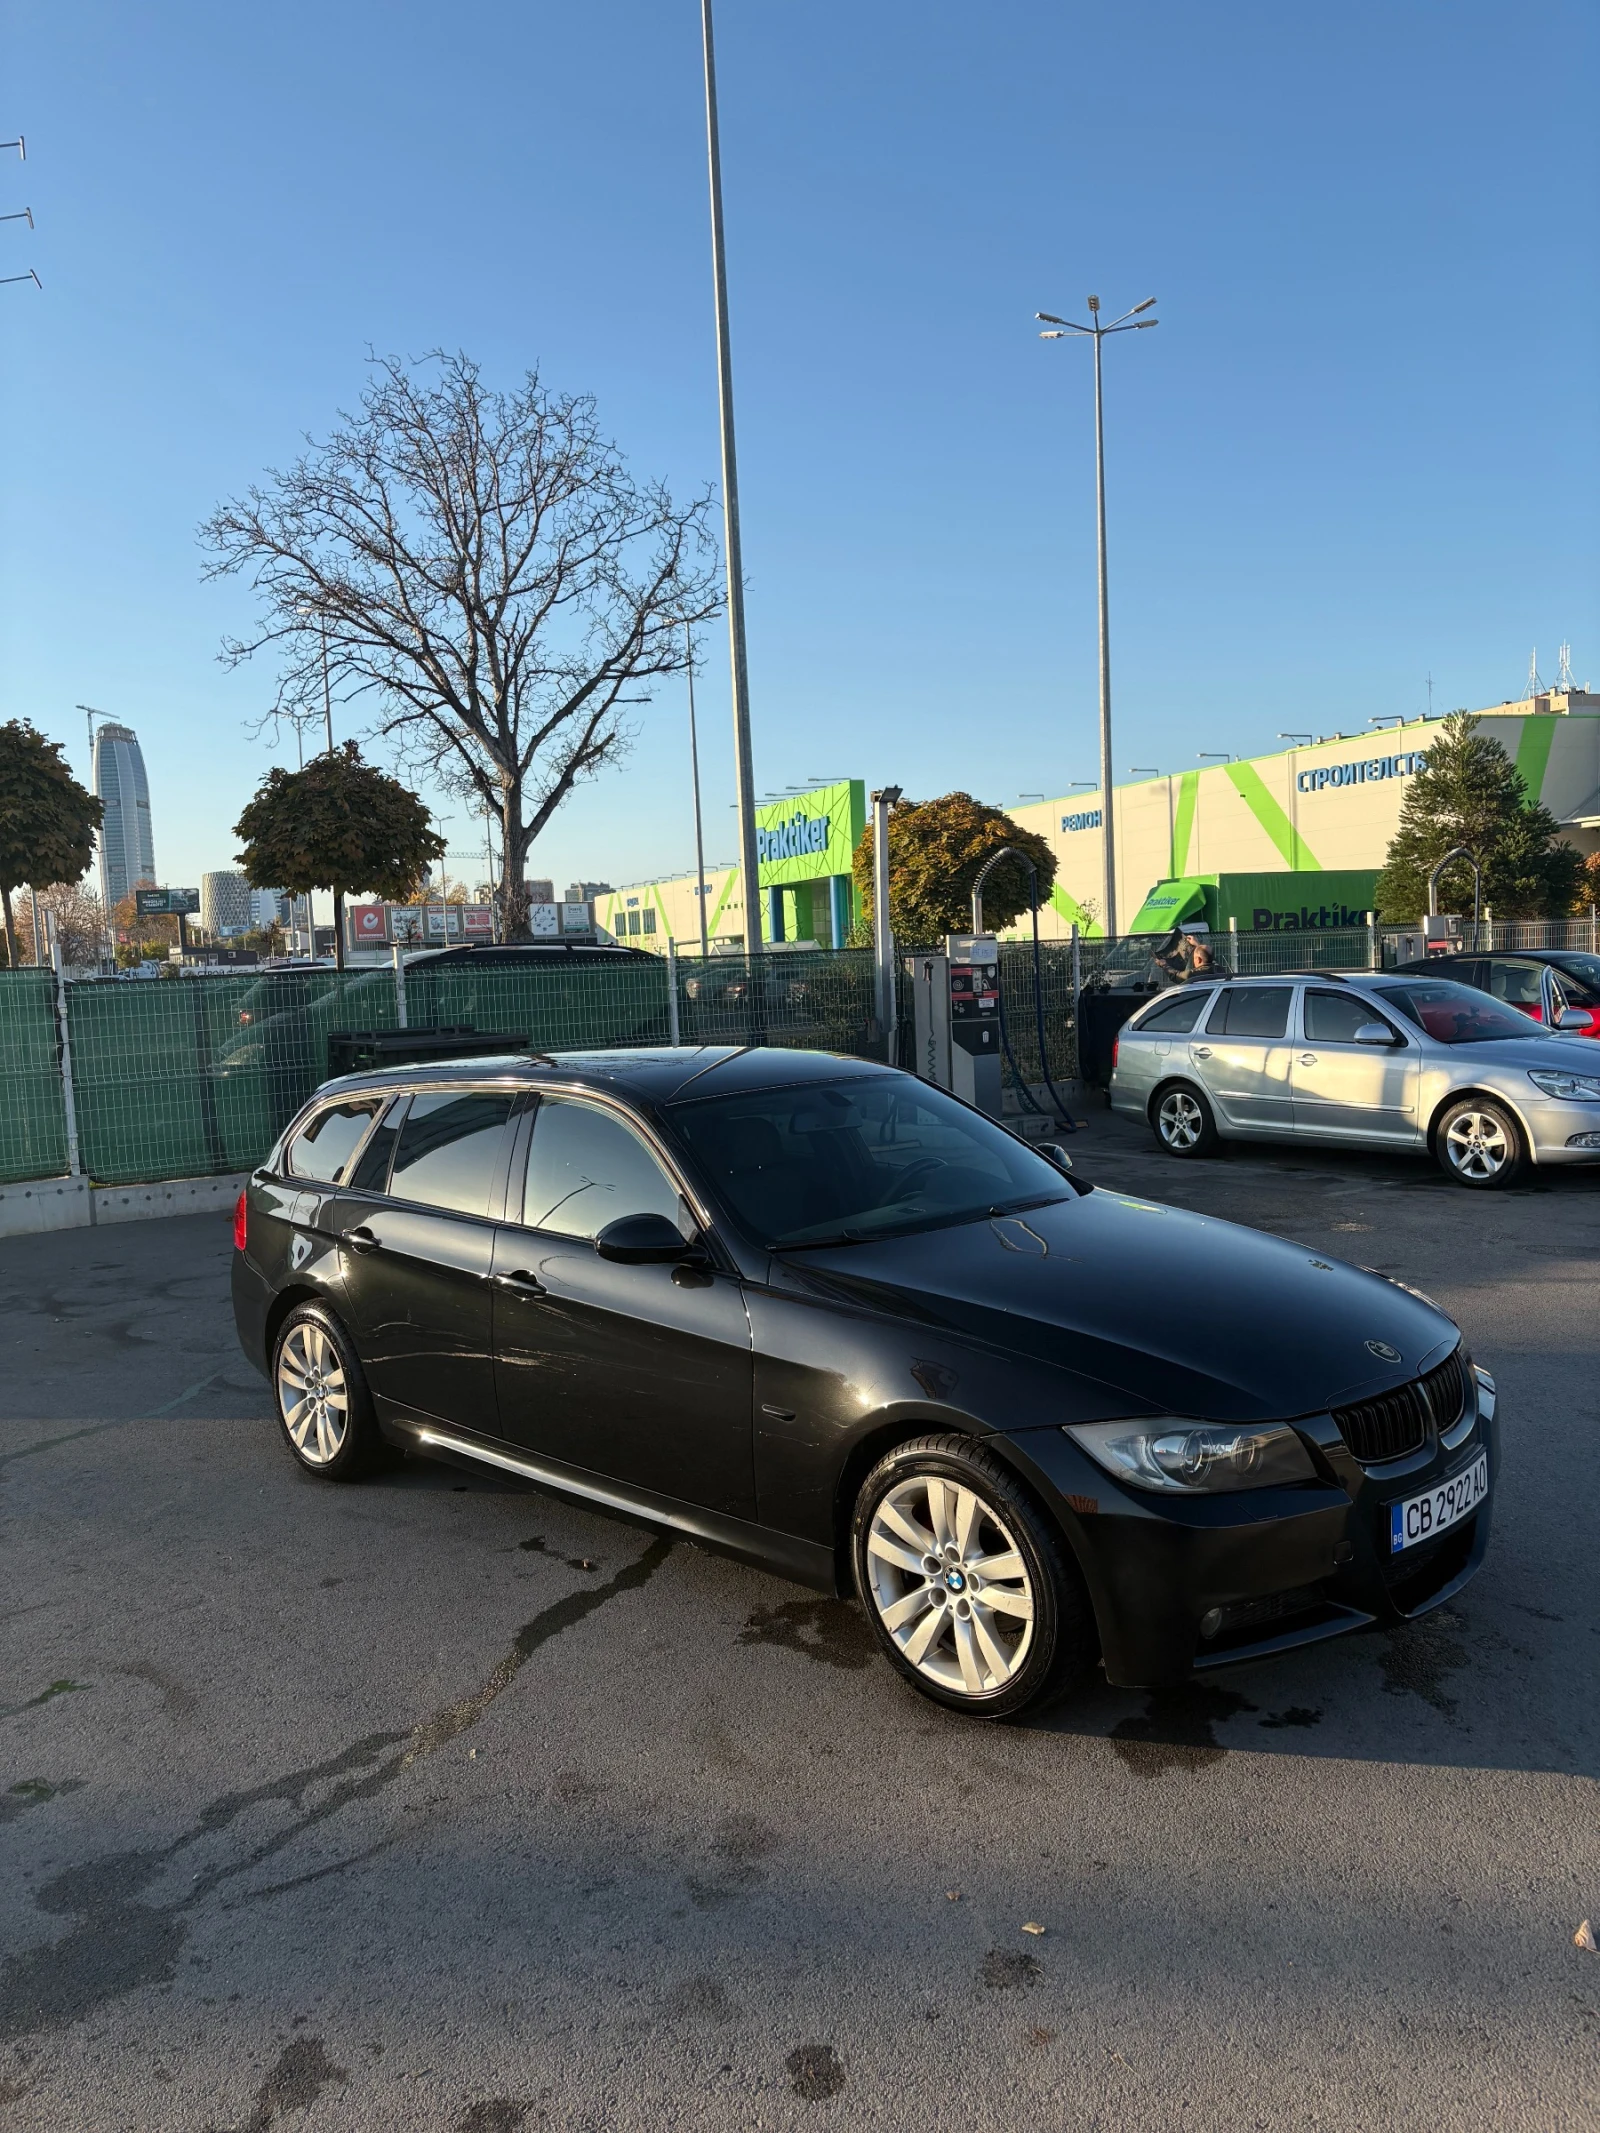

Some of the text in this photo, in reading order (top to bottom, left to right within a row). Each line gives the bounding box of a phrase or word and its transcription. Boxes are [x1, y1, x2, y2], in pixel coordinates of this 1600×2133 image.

[1297, 751, 1427, 793] СТРОИТЕЛСТВ
[756, 811, 831, 864] Praktiker
[1061, 809, 1103, 833] РЕМОН
[1407, 1460, 1486, 1539] CB 2922 AO
[1393, 1533, 1403, 1545] BG
